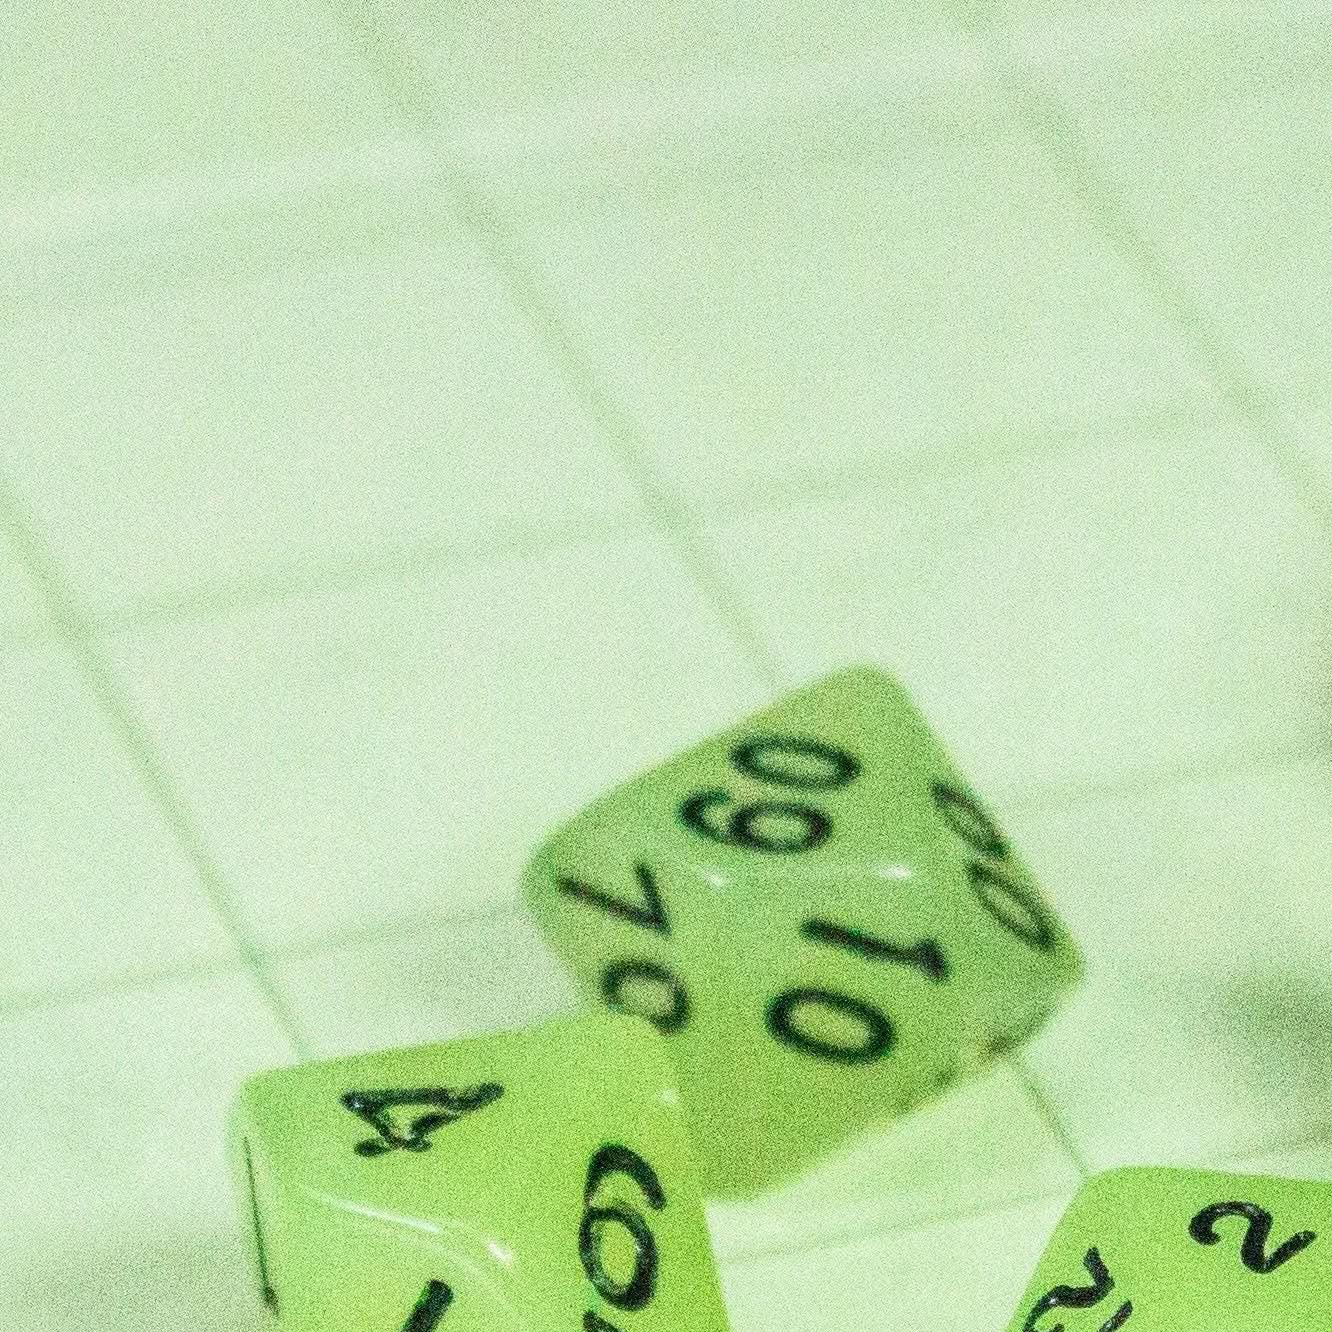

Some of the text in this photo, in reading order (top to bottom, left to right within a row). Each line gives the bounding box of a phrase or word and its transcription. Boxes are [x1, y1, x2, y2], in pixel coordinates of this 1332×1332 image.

[765, 918, 950, 1066] 10
[341, 1083, 504, 1157] 4
[1189, 1201, 1315, 1273] 2
